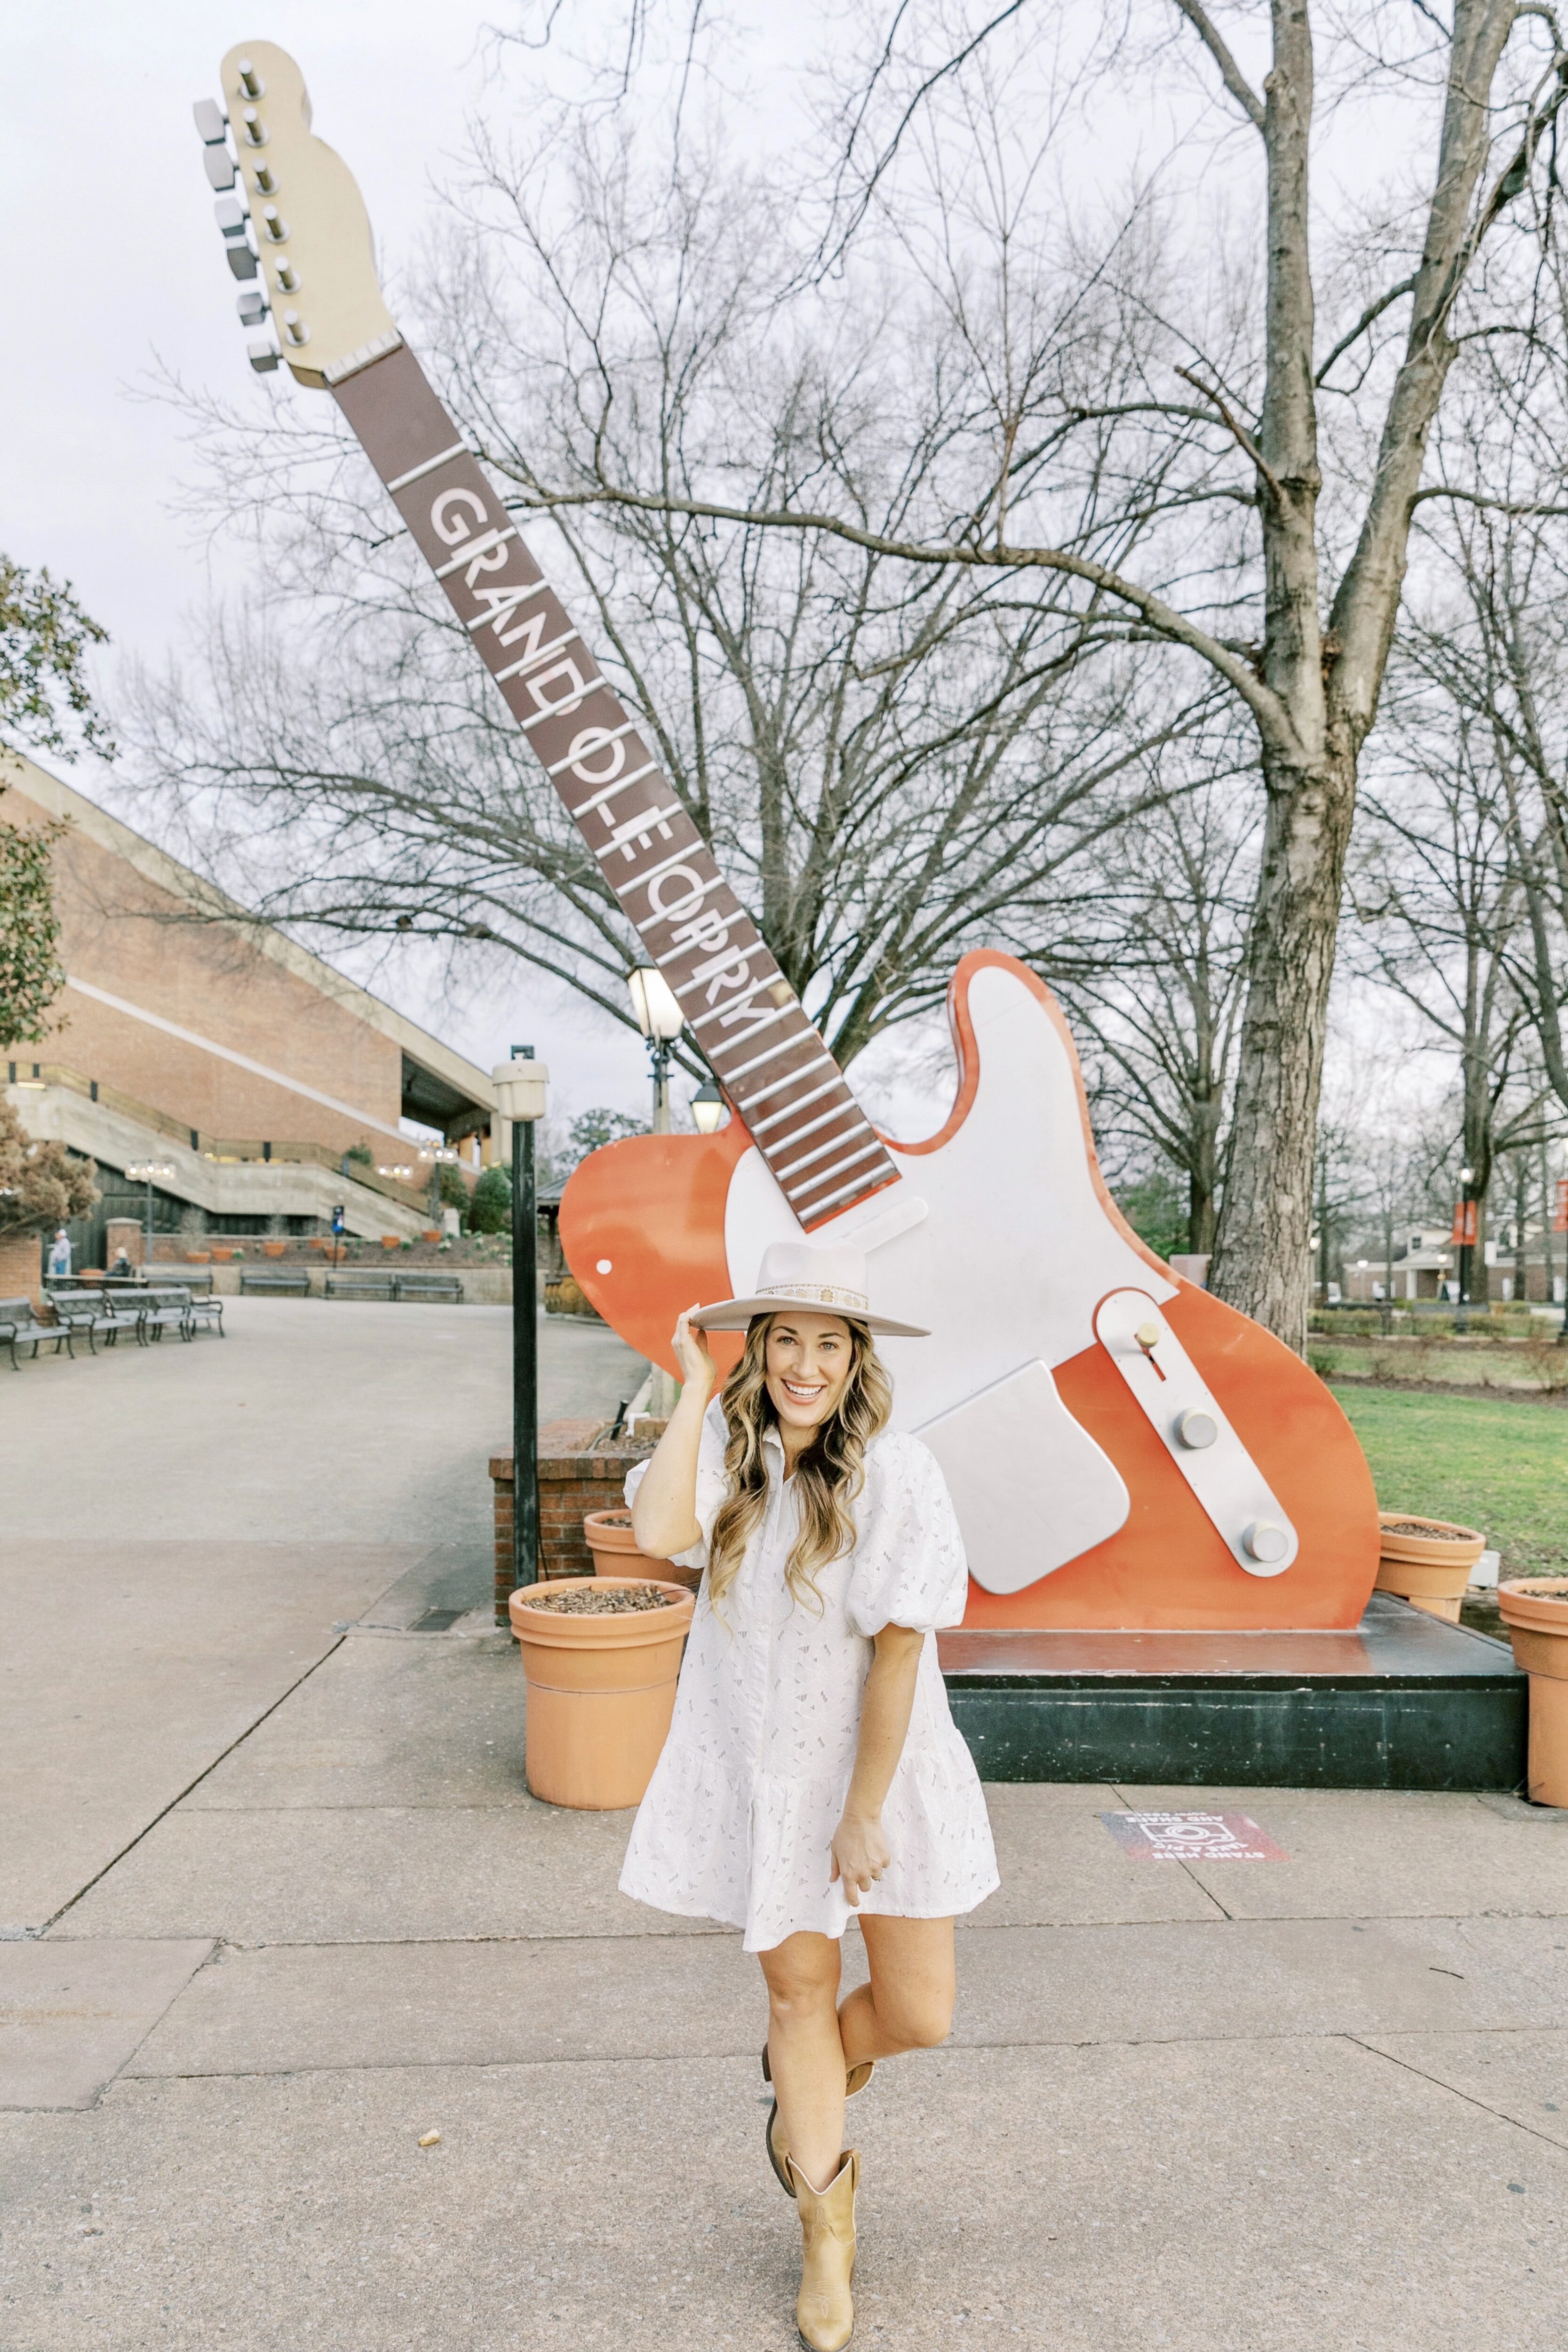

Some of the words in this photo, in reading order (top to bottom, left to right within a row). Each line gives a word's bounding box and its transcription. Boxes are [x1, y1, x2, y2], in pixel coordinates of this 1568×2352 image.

[430, 487, 586, 716] GRAND
[647, 864, 776, 1028] OPRY
[1153, 1843, 1184, 1851] PIC
[1205, 1842, 1249, 1852] TAKE
